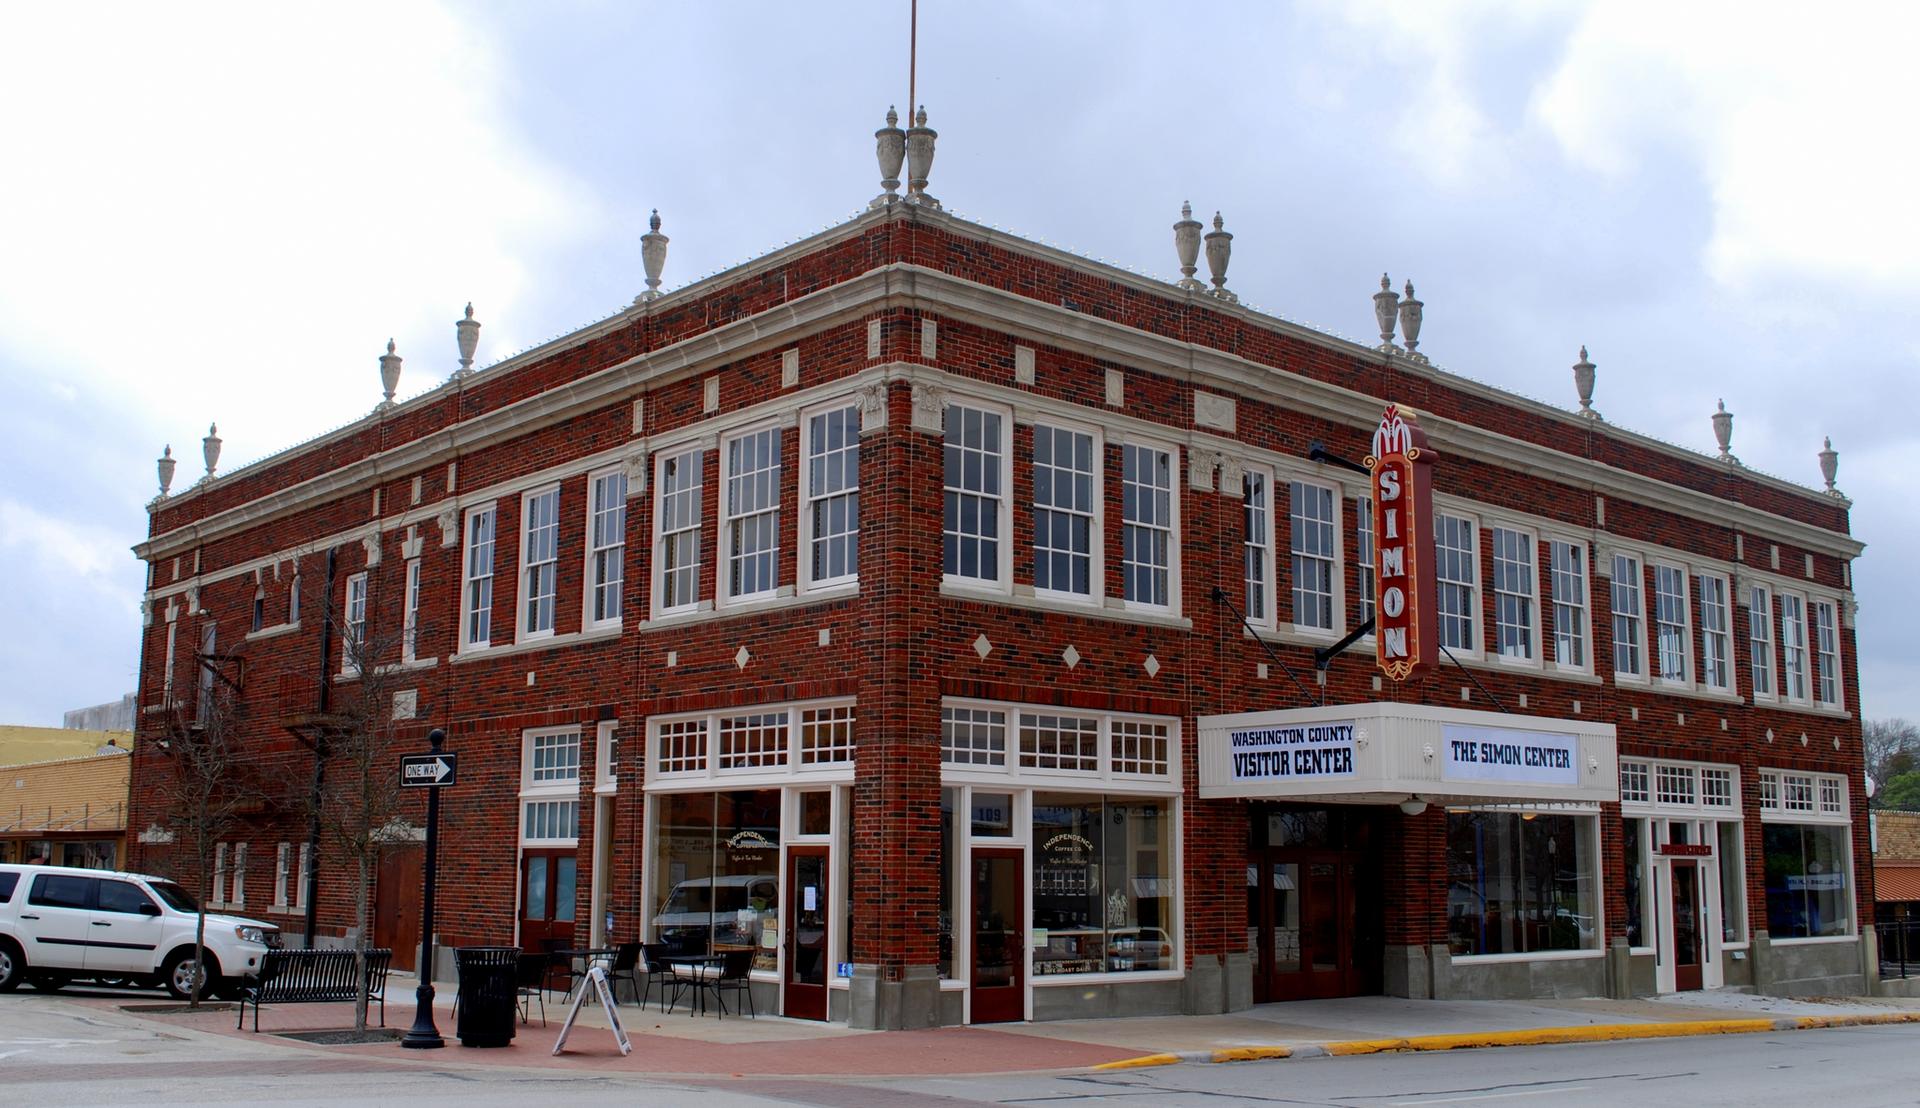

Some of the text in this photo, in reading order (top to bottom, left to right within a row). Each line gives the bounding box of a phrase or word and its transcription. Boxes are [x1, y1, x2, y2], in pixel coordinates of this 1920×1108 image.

[1379, 470, 1409, 659] SIMON
[1232, 725, 1353, 746] WASHINGTON COUNTY
[1234, 748, 1352, 777] VISITOR CENTER
[1451, 741, 1570, 768] THE SIMON CENTER
[407, 764, 440, 776] ONE WAY
[979, 808, 1000, 821] 109
[1043, 834, 1094, 851] INDEPENDENCE
